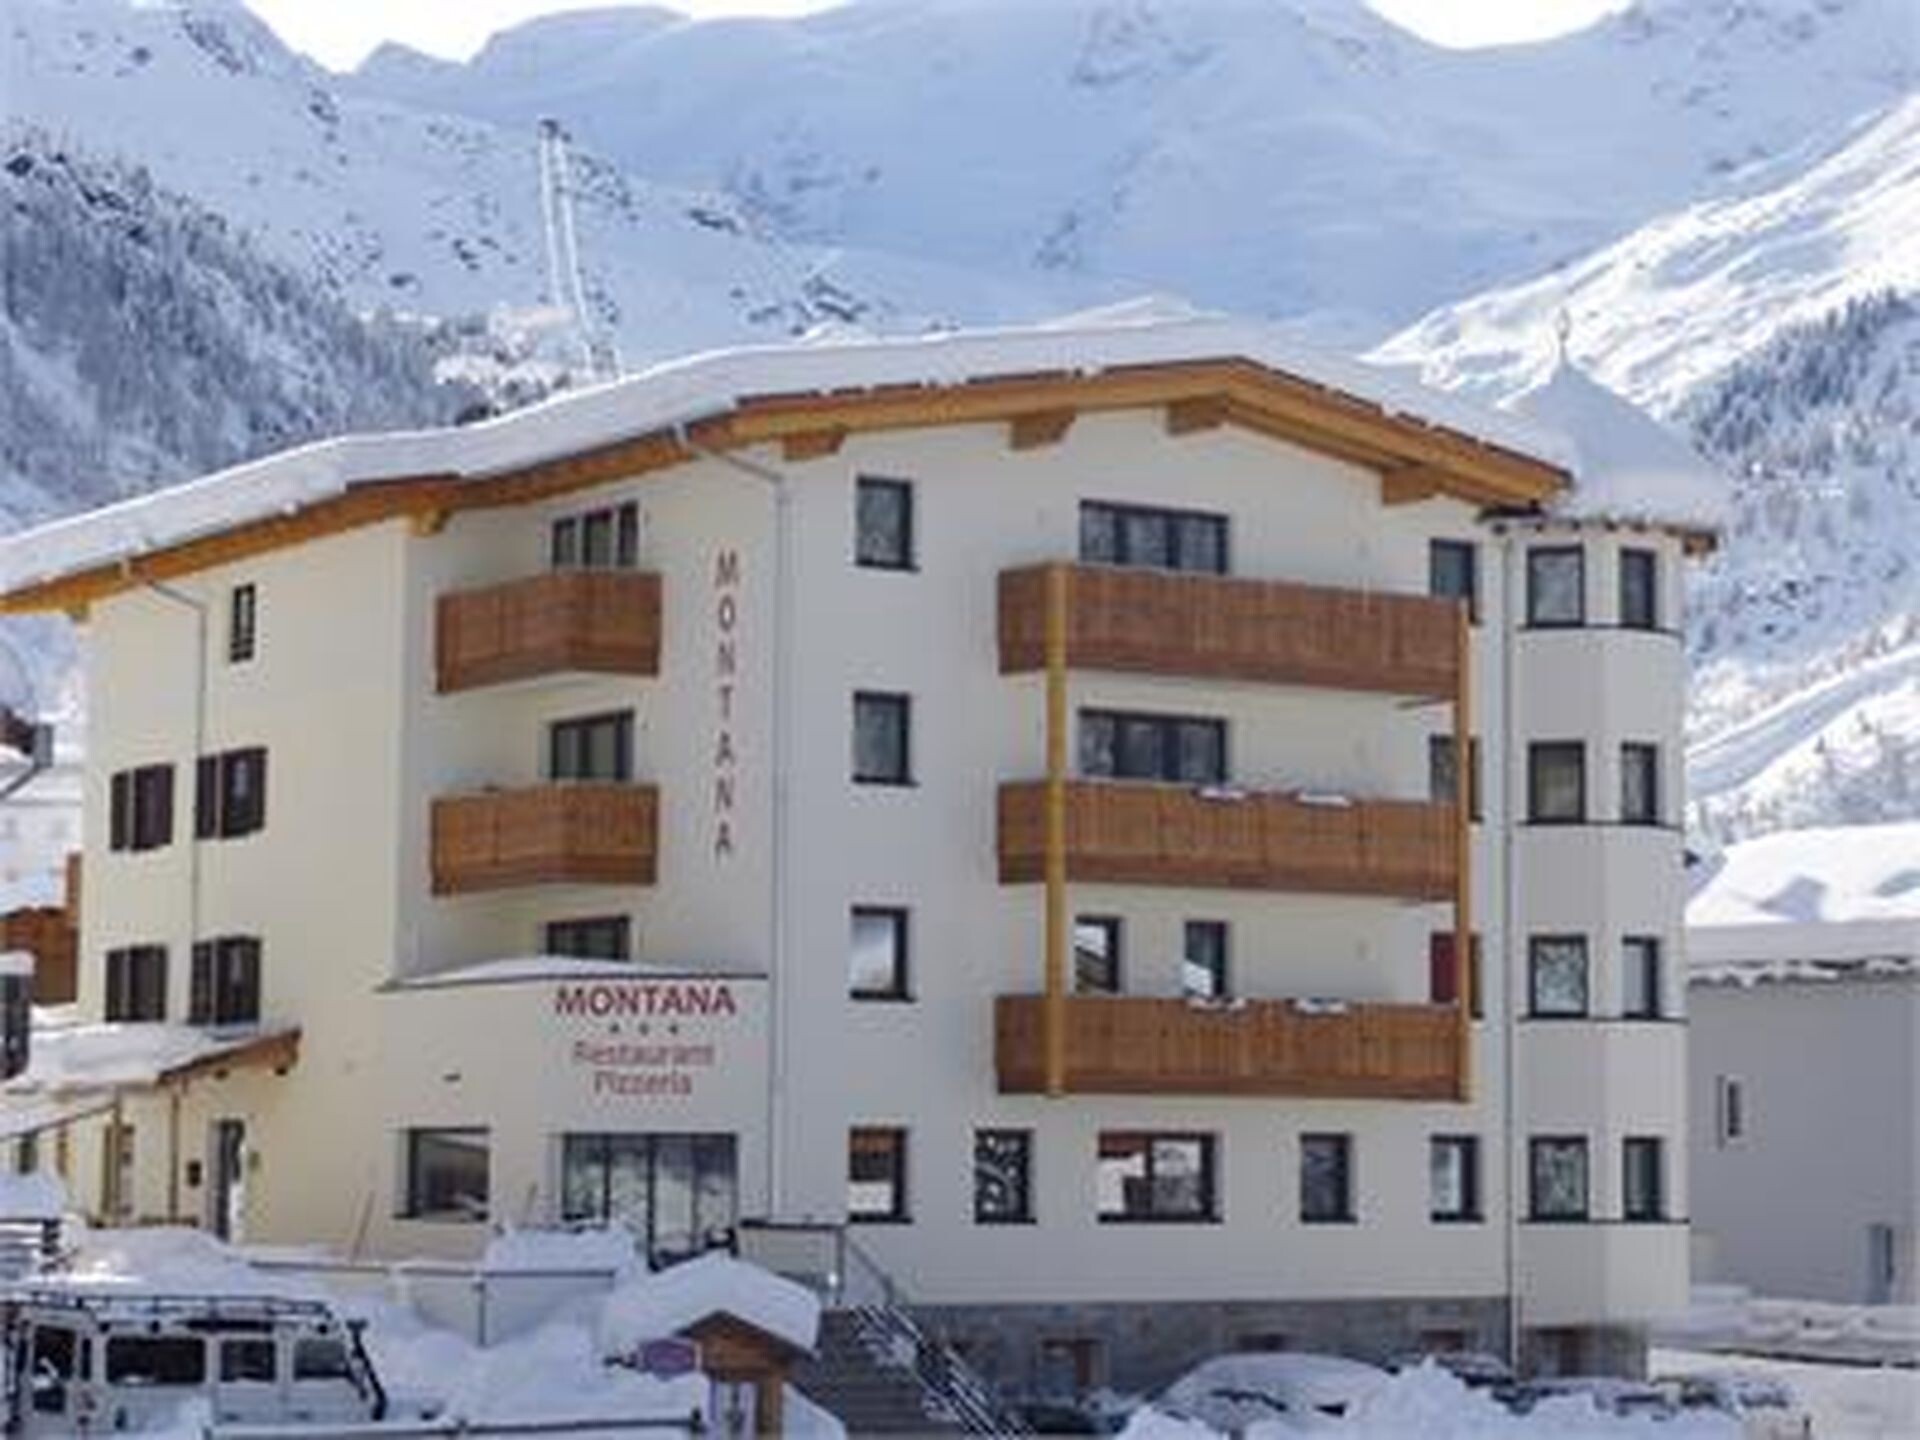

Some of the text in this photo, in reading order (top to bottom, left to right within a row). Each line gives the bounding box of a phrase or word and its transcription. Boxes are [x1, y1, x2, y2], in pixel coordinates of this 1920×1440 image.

[714, 549, 739, 860] MONTANA
[555, 985, 737, 1016] MONTANA
[573, 1041, 714, 1066] Restaurant
[594, 1071, 692, 1095] Pizzeria
